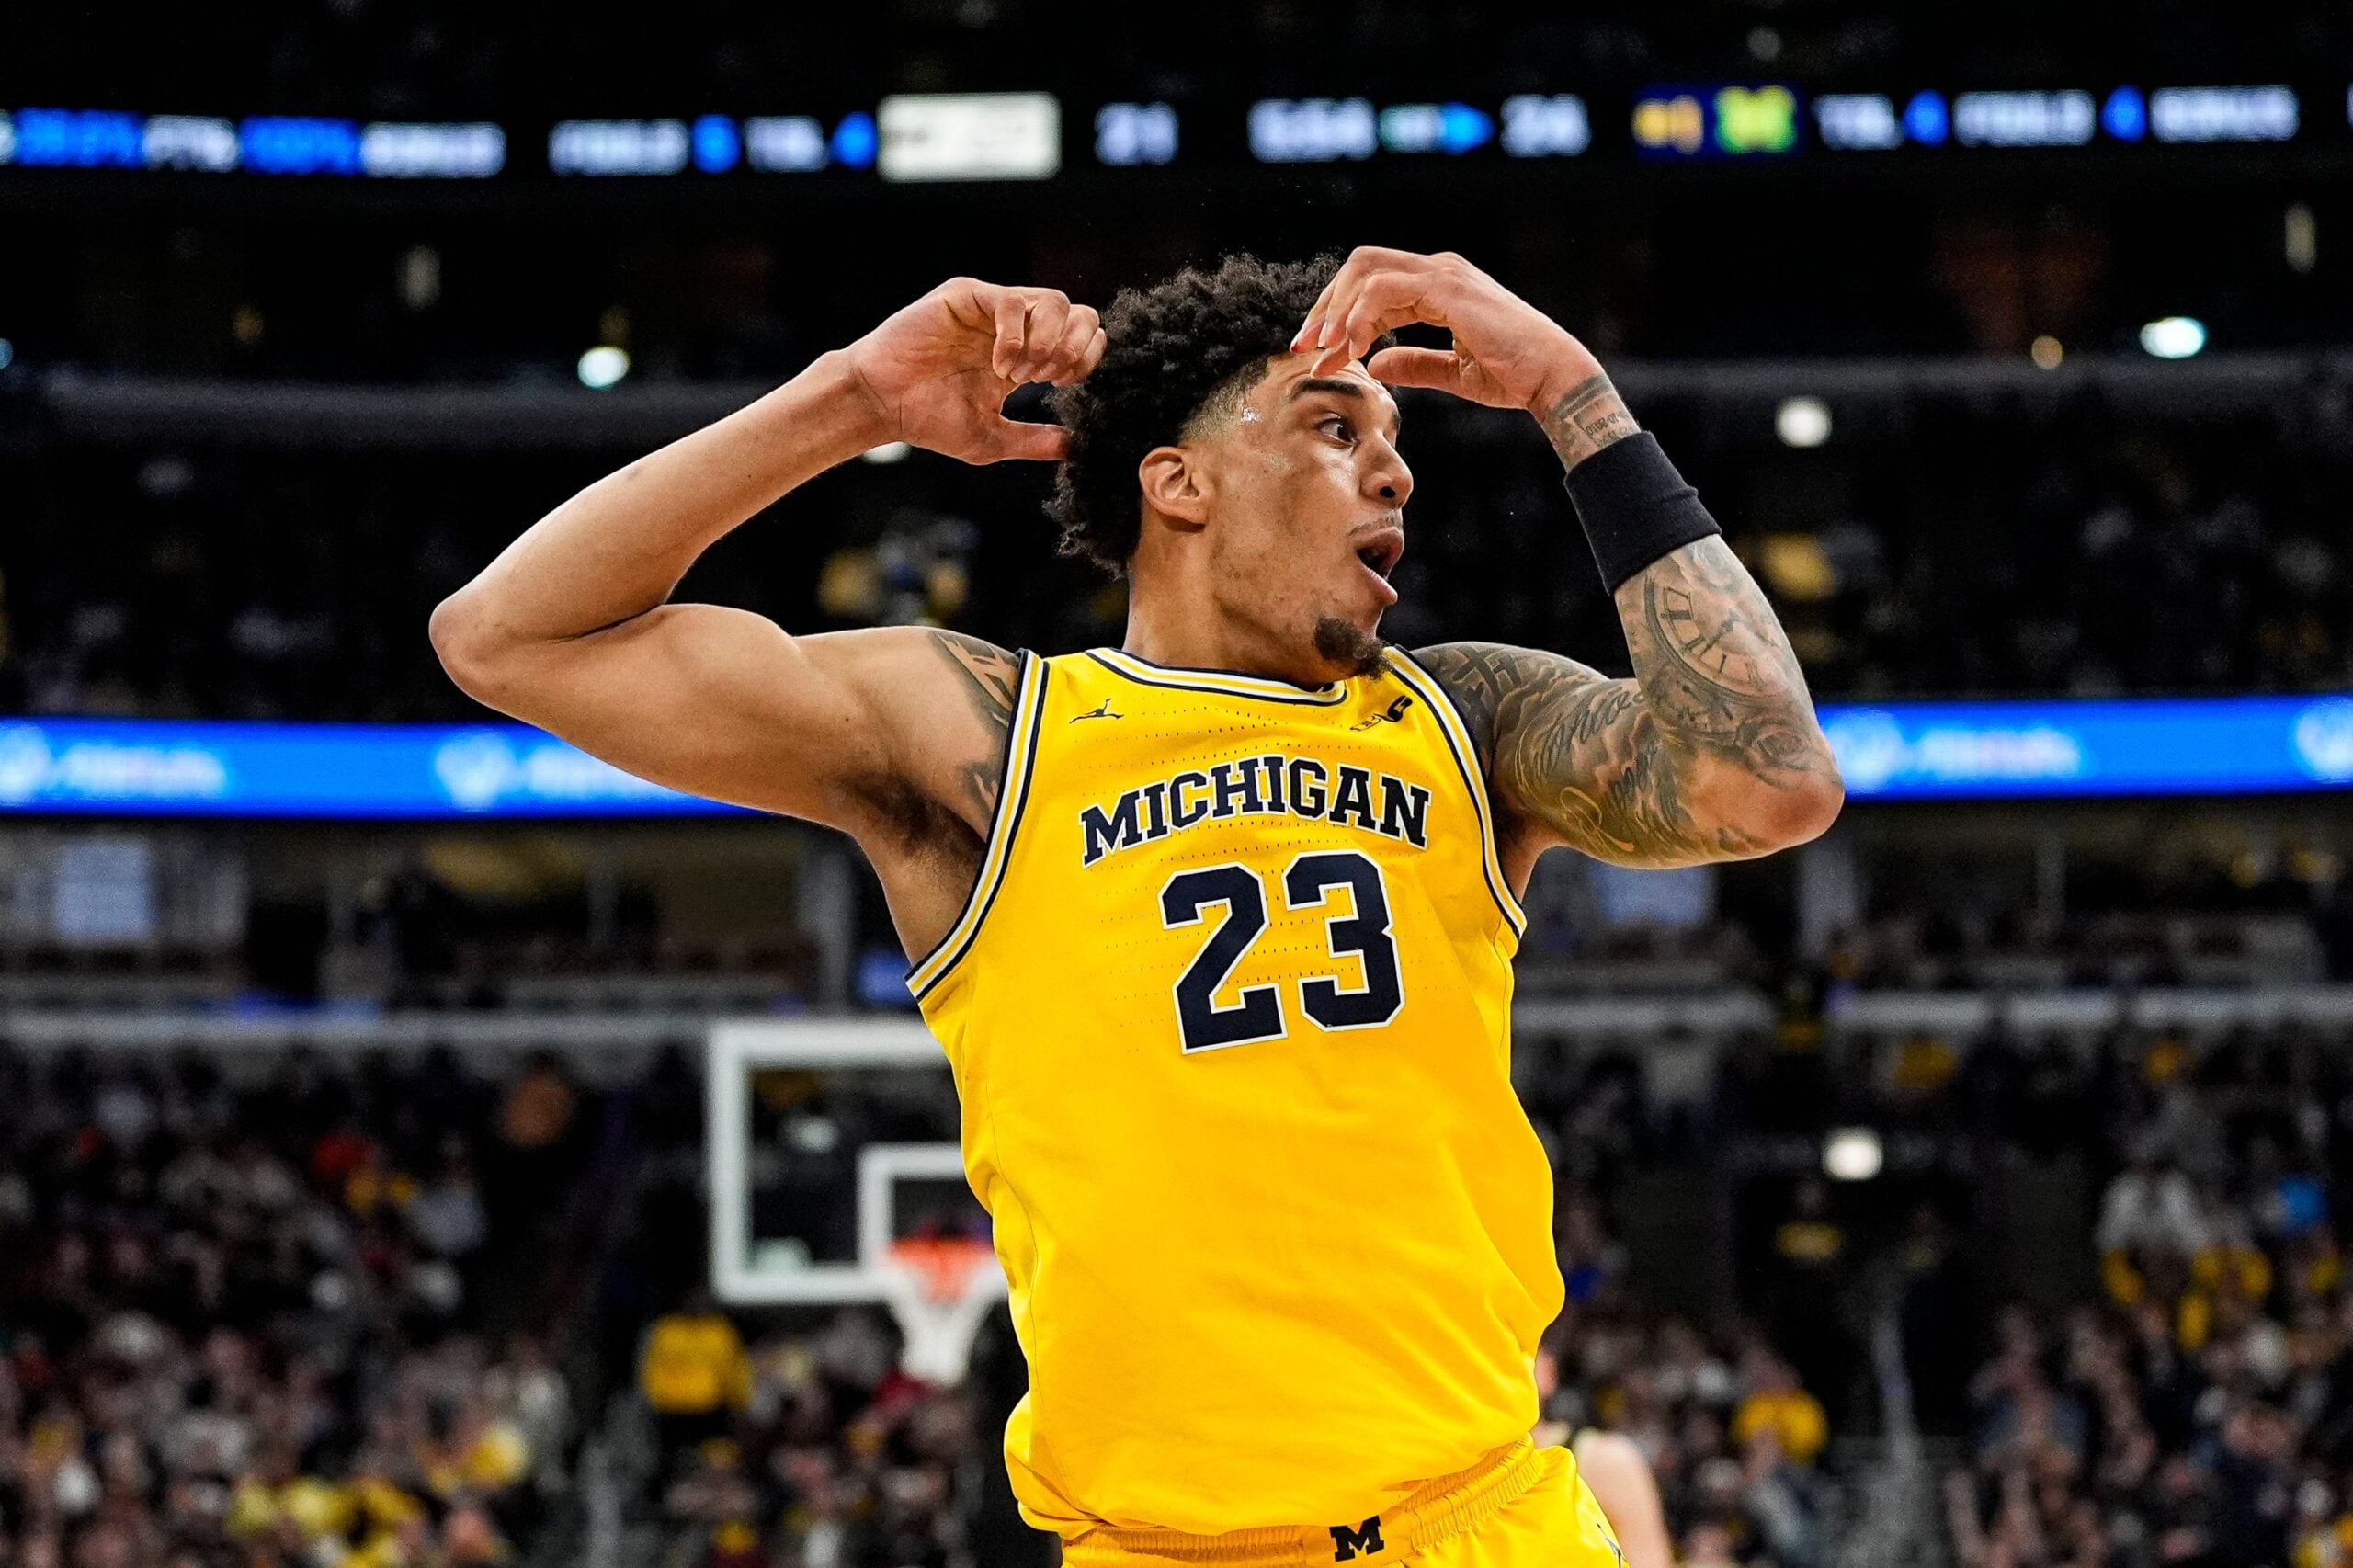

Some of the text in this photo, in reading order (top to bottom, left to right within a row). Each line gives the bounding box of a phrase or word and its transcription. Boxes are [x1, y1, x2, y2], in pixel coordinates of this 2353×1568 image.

[1080, 754, 1432, 869] MICHIGAN
[1157, 849, 1405, 1055] 23
[1328, 1515, 1384, 1562] M
